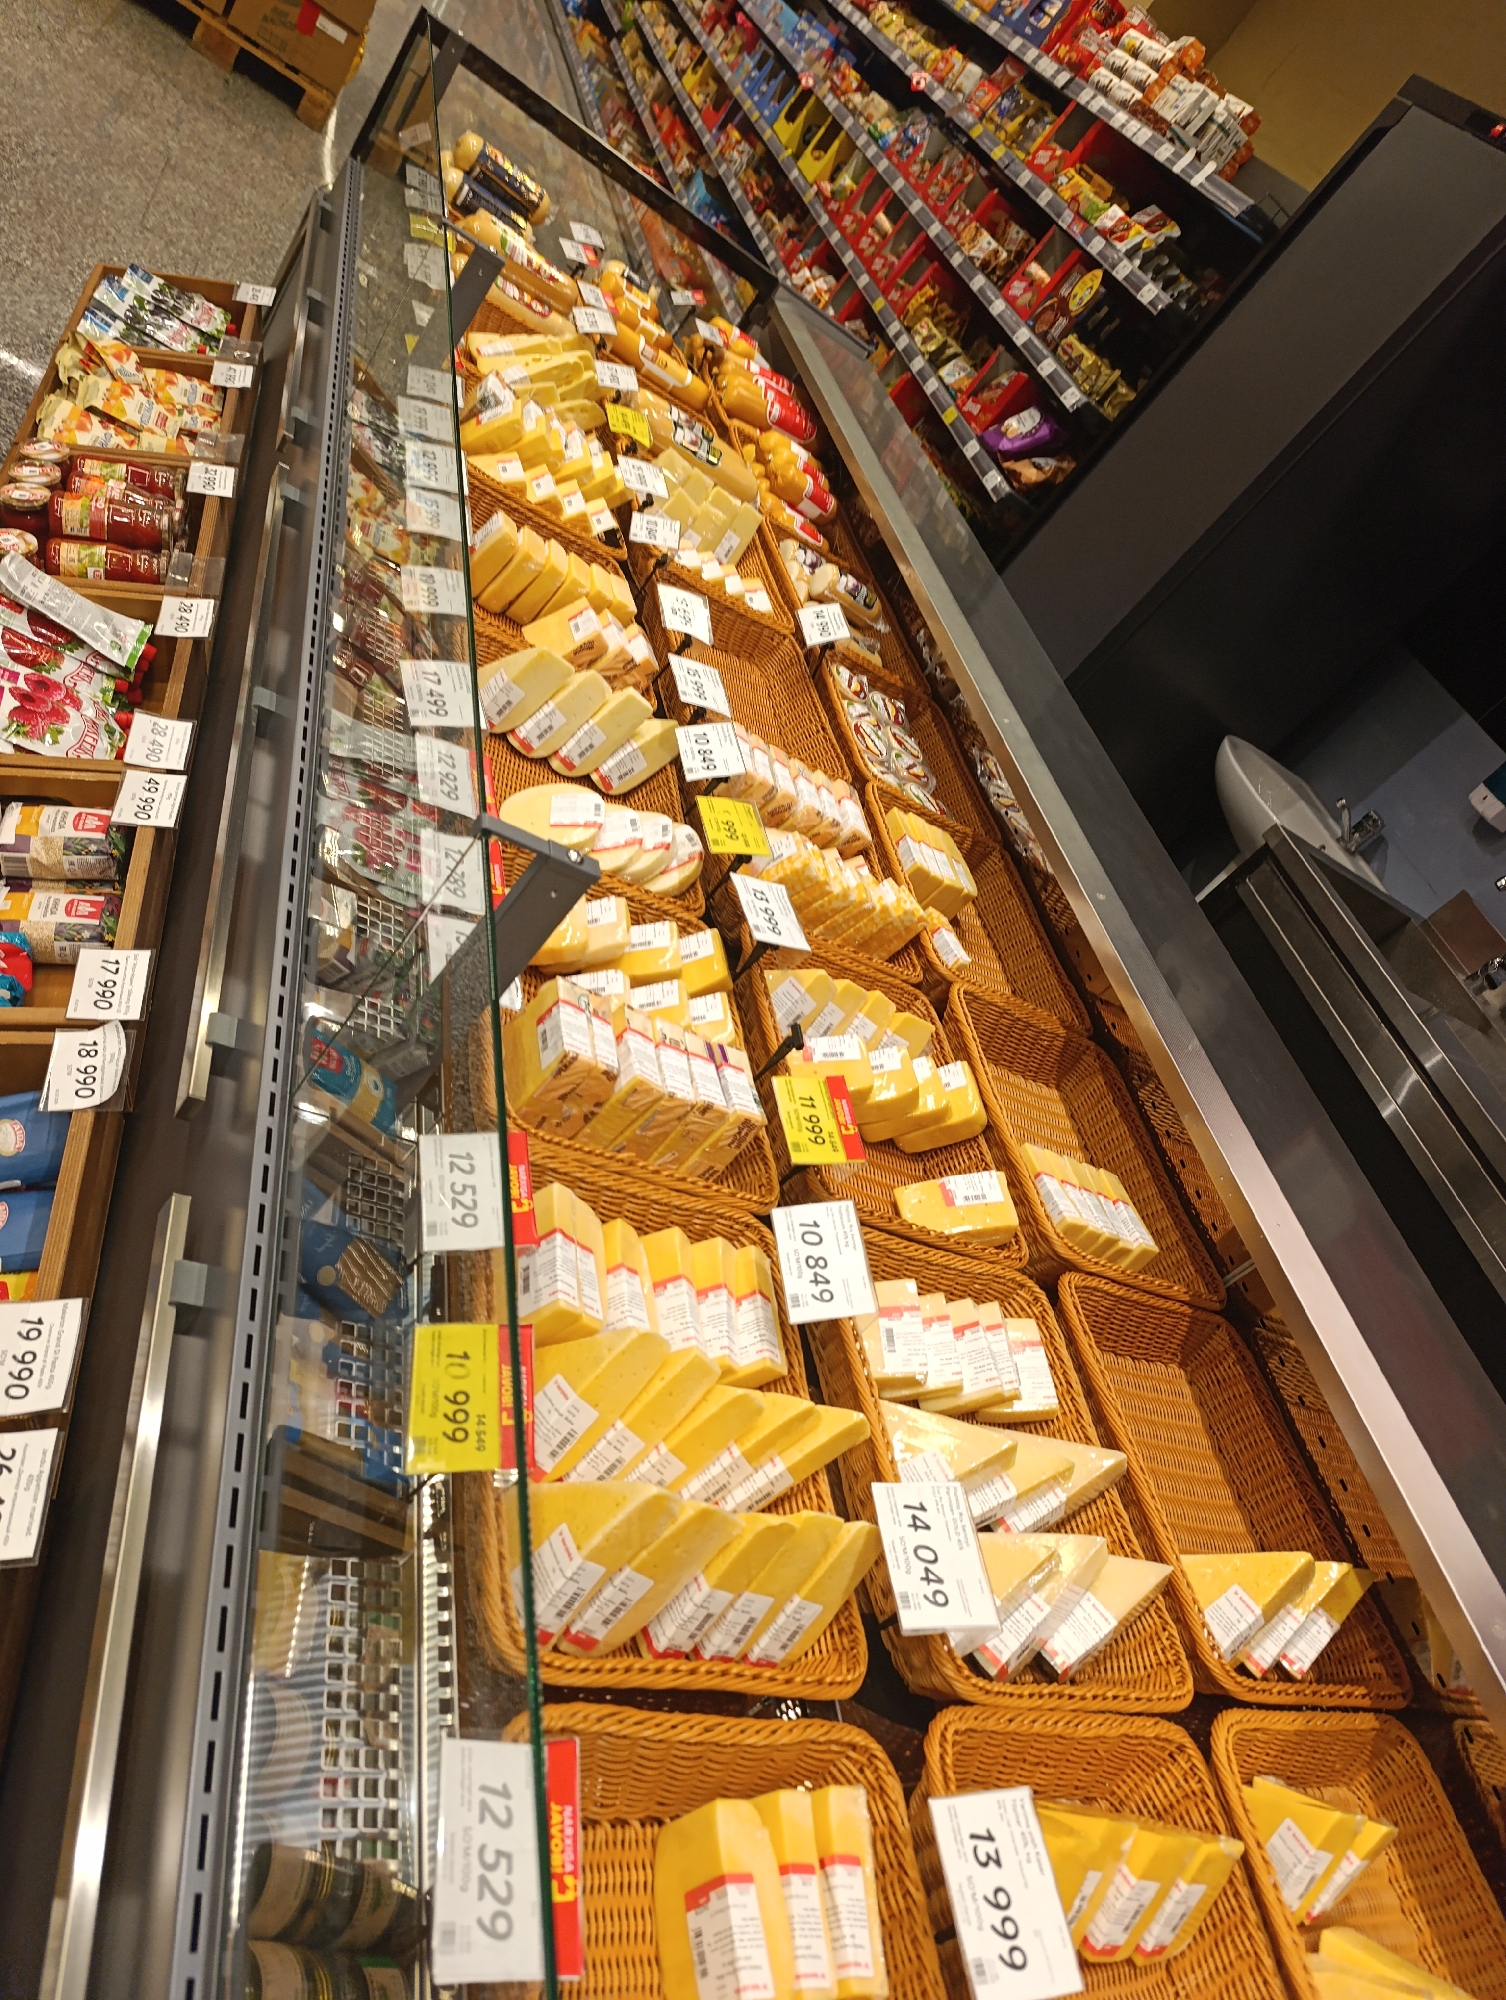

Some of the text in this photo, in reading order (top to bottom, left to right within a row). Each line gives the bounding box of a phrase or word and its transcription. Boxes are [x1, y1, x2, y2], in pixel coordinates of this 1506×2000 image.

[424, 463, 438, 482] 999
[425, 509, 440, 529] 999
[419, 573, 439, 607] 19 999
[173, 601, 193, 633] 28 490
[422, 671, 448, 717] 17 499
[690, 680, 707, 701] 999
[145, 722, 169, 762] 28 490
[693, 732, 717, 771] 10 849
[437, 752, 459, 801] 12 929
[134, 778, 160, 820] 49 990
[721, 820, 739, 841] 999
[445, 865, 466, 899] 789
[752, 887, 782, 936] 13 999
[100, 959, 121, 975] 17
[93, 979, 117, 1010] 990
[75, 1039, 99, 1099] 18 990
[12, 1123, 25, 1151] AIDA
[798, 1095, 826, 1145] 11 999
[448, 1152, 479, 1229] 12 529
[509, 1163, 521, 1199] JAVOB!
[518, 1164, 528, 1198] NARXIGA
[798, 1220, 835, 1304] 10 849
[4, 1316, 45, 1400] 19 990
[442, 1351, 471, 1444] 10 999
[902, 1502, 932, 1533] 14
[913, 1544, 950, 1609] 049
[549, 1801, 564, 1875] JAVOB!
[562, 1804, 575, 1874] NARXIGA
[968, 1827, 1003, 1870] 13
[475, 1782, 515, 1943] 12 529
[982, 1885, 1029, 1973] 999
